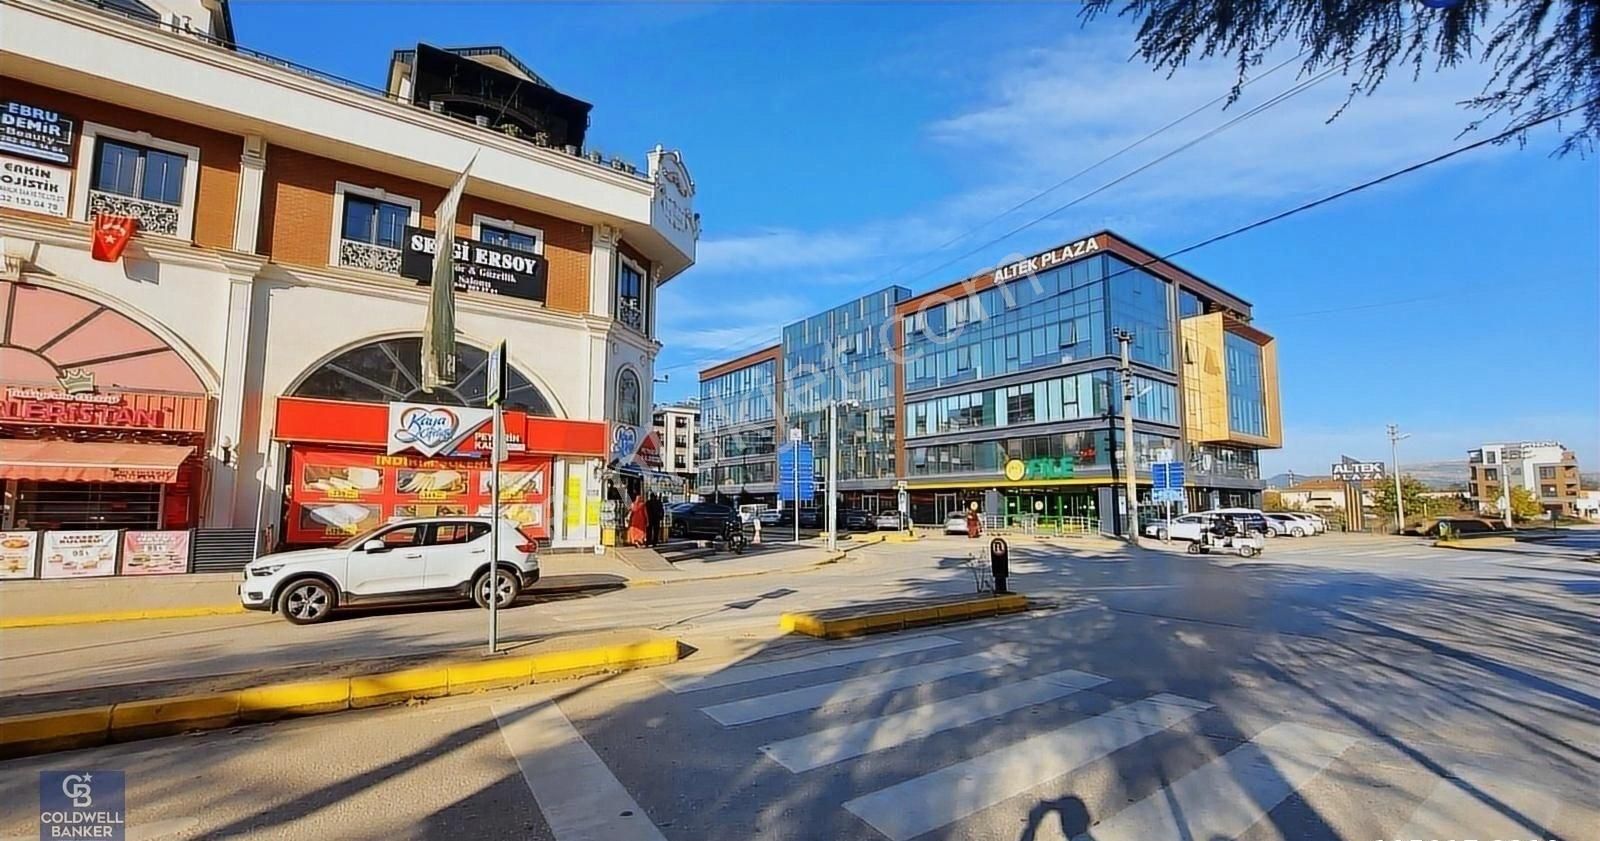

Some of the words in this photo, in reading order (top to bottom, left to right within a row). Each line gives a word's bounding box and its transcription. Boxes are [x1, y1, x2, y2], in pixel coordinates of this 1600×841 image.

[9, 102, 58, 122] EBRU
[6, 127, 55, 144] Beauty
[411, 234, 470, 261] SEGİ
[475, 247, 537, 275] ERSOY
[993, 255, 1039, 284] ALTEK
[1041, 237, 1100, 268] PLAZA
[408, 413, 447, 430] Kaya
[1332, 473, 1383, 481] PLAZA
[1333, 463, 1383, 475] ALTEK
